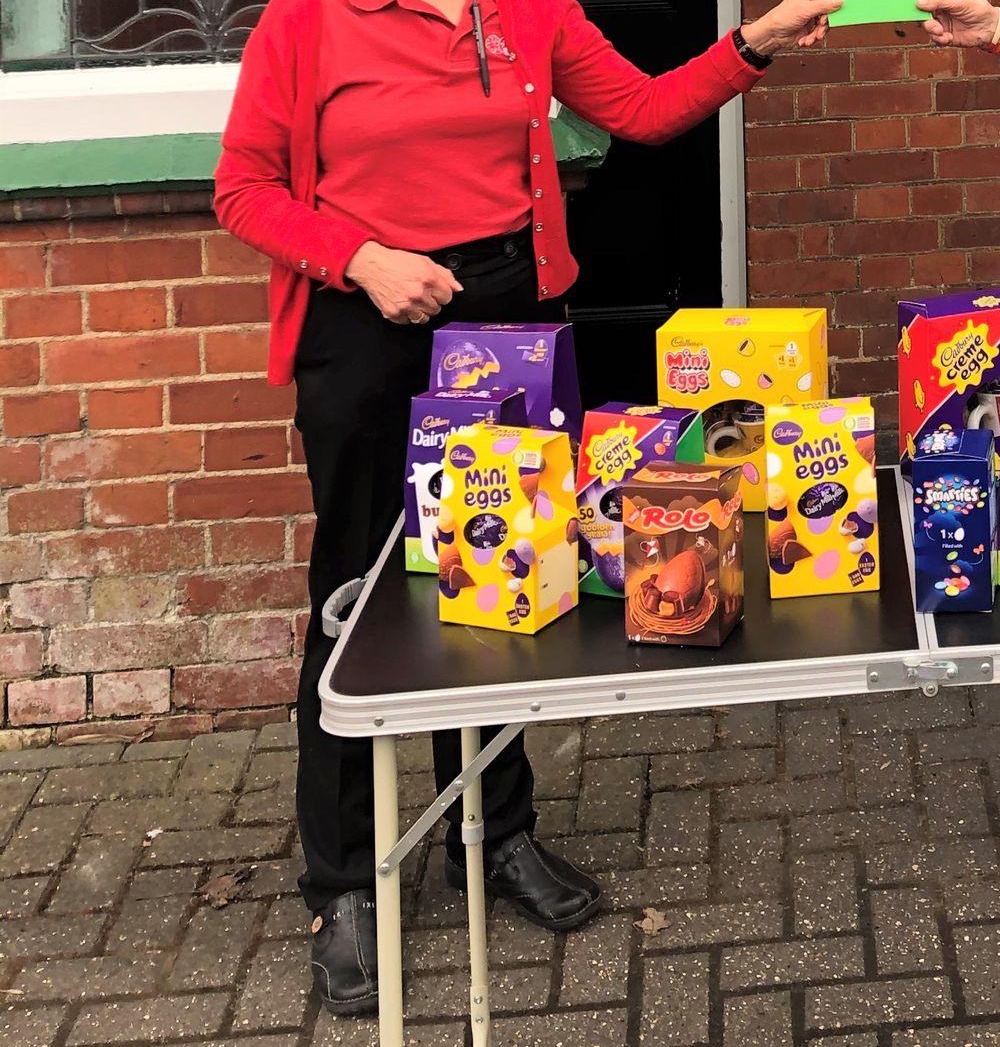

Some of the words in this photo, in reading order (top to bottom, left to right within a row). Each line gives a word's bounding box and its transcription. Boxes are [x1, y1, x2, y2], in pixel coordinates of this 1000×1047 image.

[443, 352, 484, 371] Cadbury
[666, 349, 710, 370] Mini
[940, 332, 974, 367] Cadbury
[946, 335, 984, 381] creme
[960, 348, 989, 381] egg
[667, 369, 710, 393] Eggs
[421, 415, 450, 429] Cadbury
[773, 427, 802, 439] Cadbury
[412, 427, 447, 450] Dairy
[793, 432, 842, 463] Mini
[450, 450, 476, 463] Cadbury
[595, 435, 630, 471] creme
[606, 449, 632, 474] egg
[464, 464, 507, 490] Mini
[795, 454, 849, 480] eggs
[464, 487, 512, 510] eggs
[579, 507, 595, 521] 50
